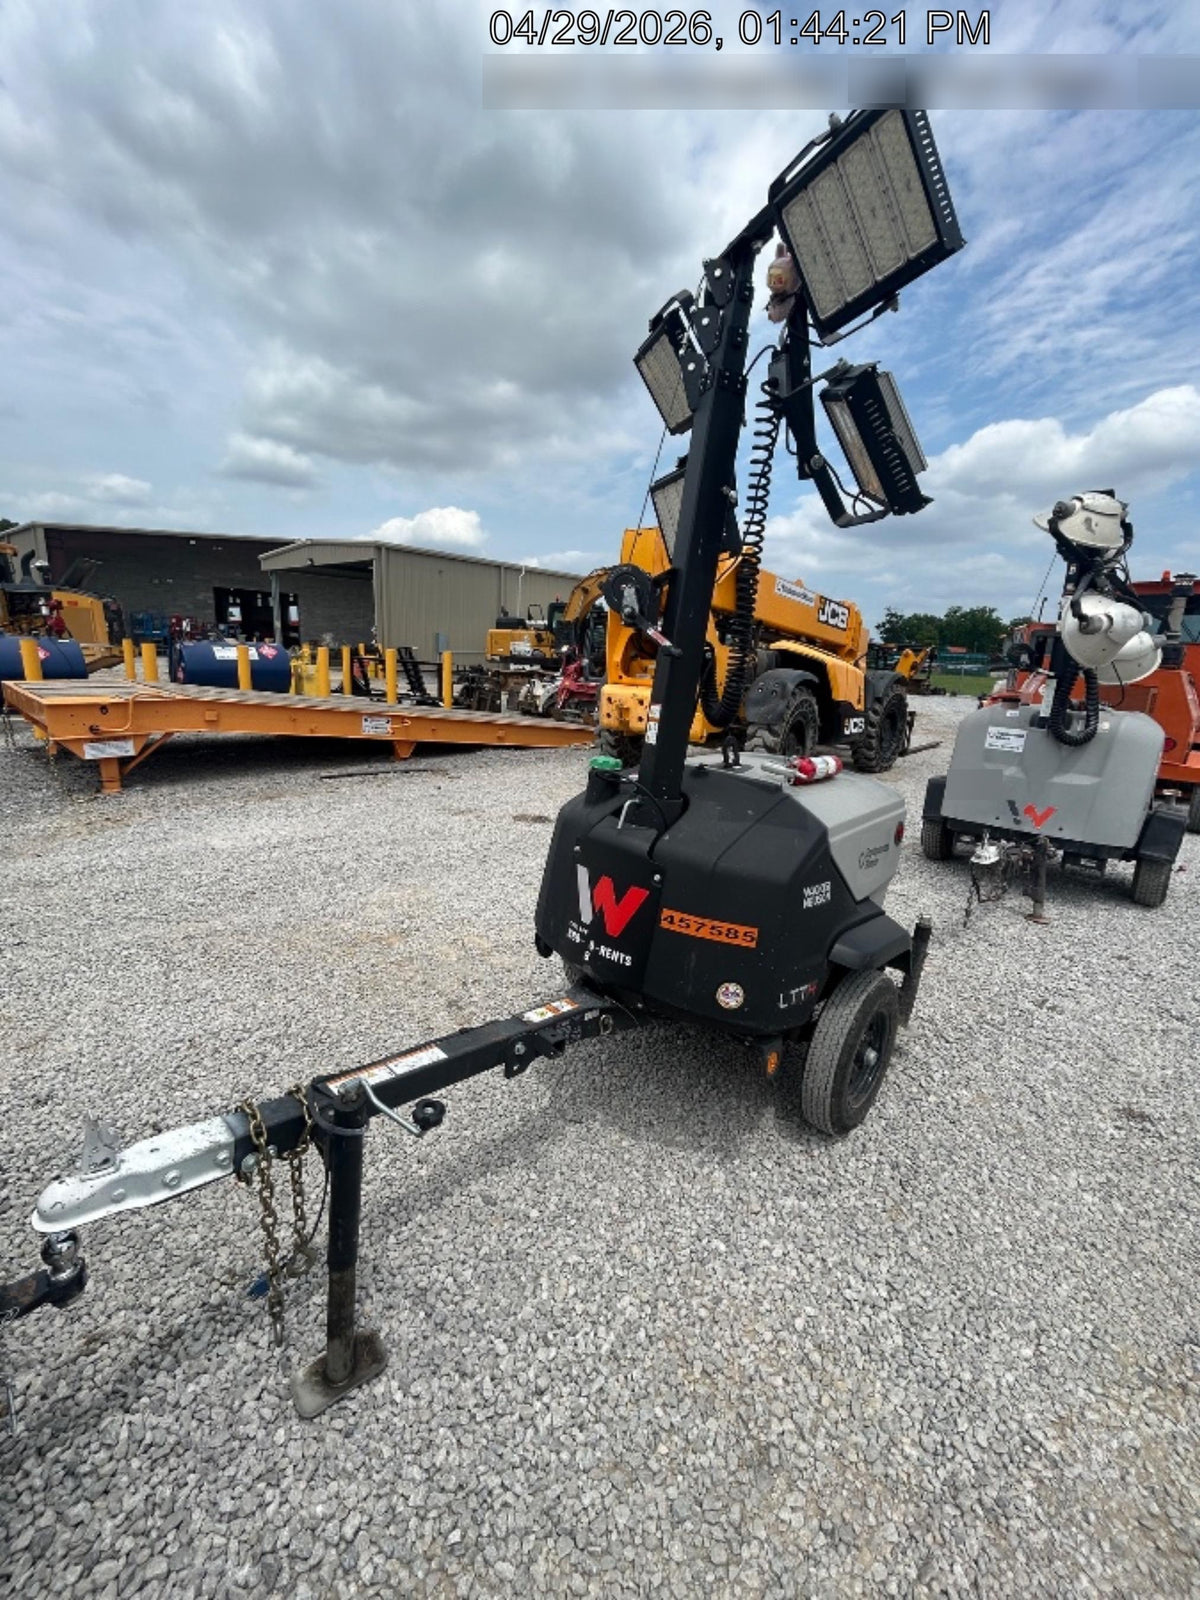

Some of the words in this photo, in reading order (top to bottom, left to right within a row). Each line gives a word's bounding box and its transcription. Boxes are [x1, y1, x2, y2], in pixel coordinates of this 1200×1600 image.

[818, 597, 850, 631] JCB
[843, 717, 865, 735] JCB
[662, 914, 756, 943] 457585
